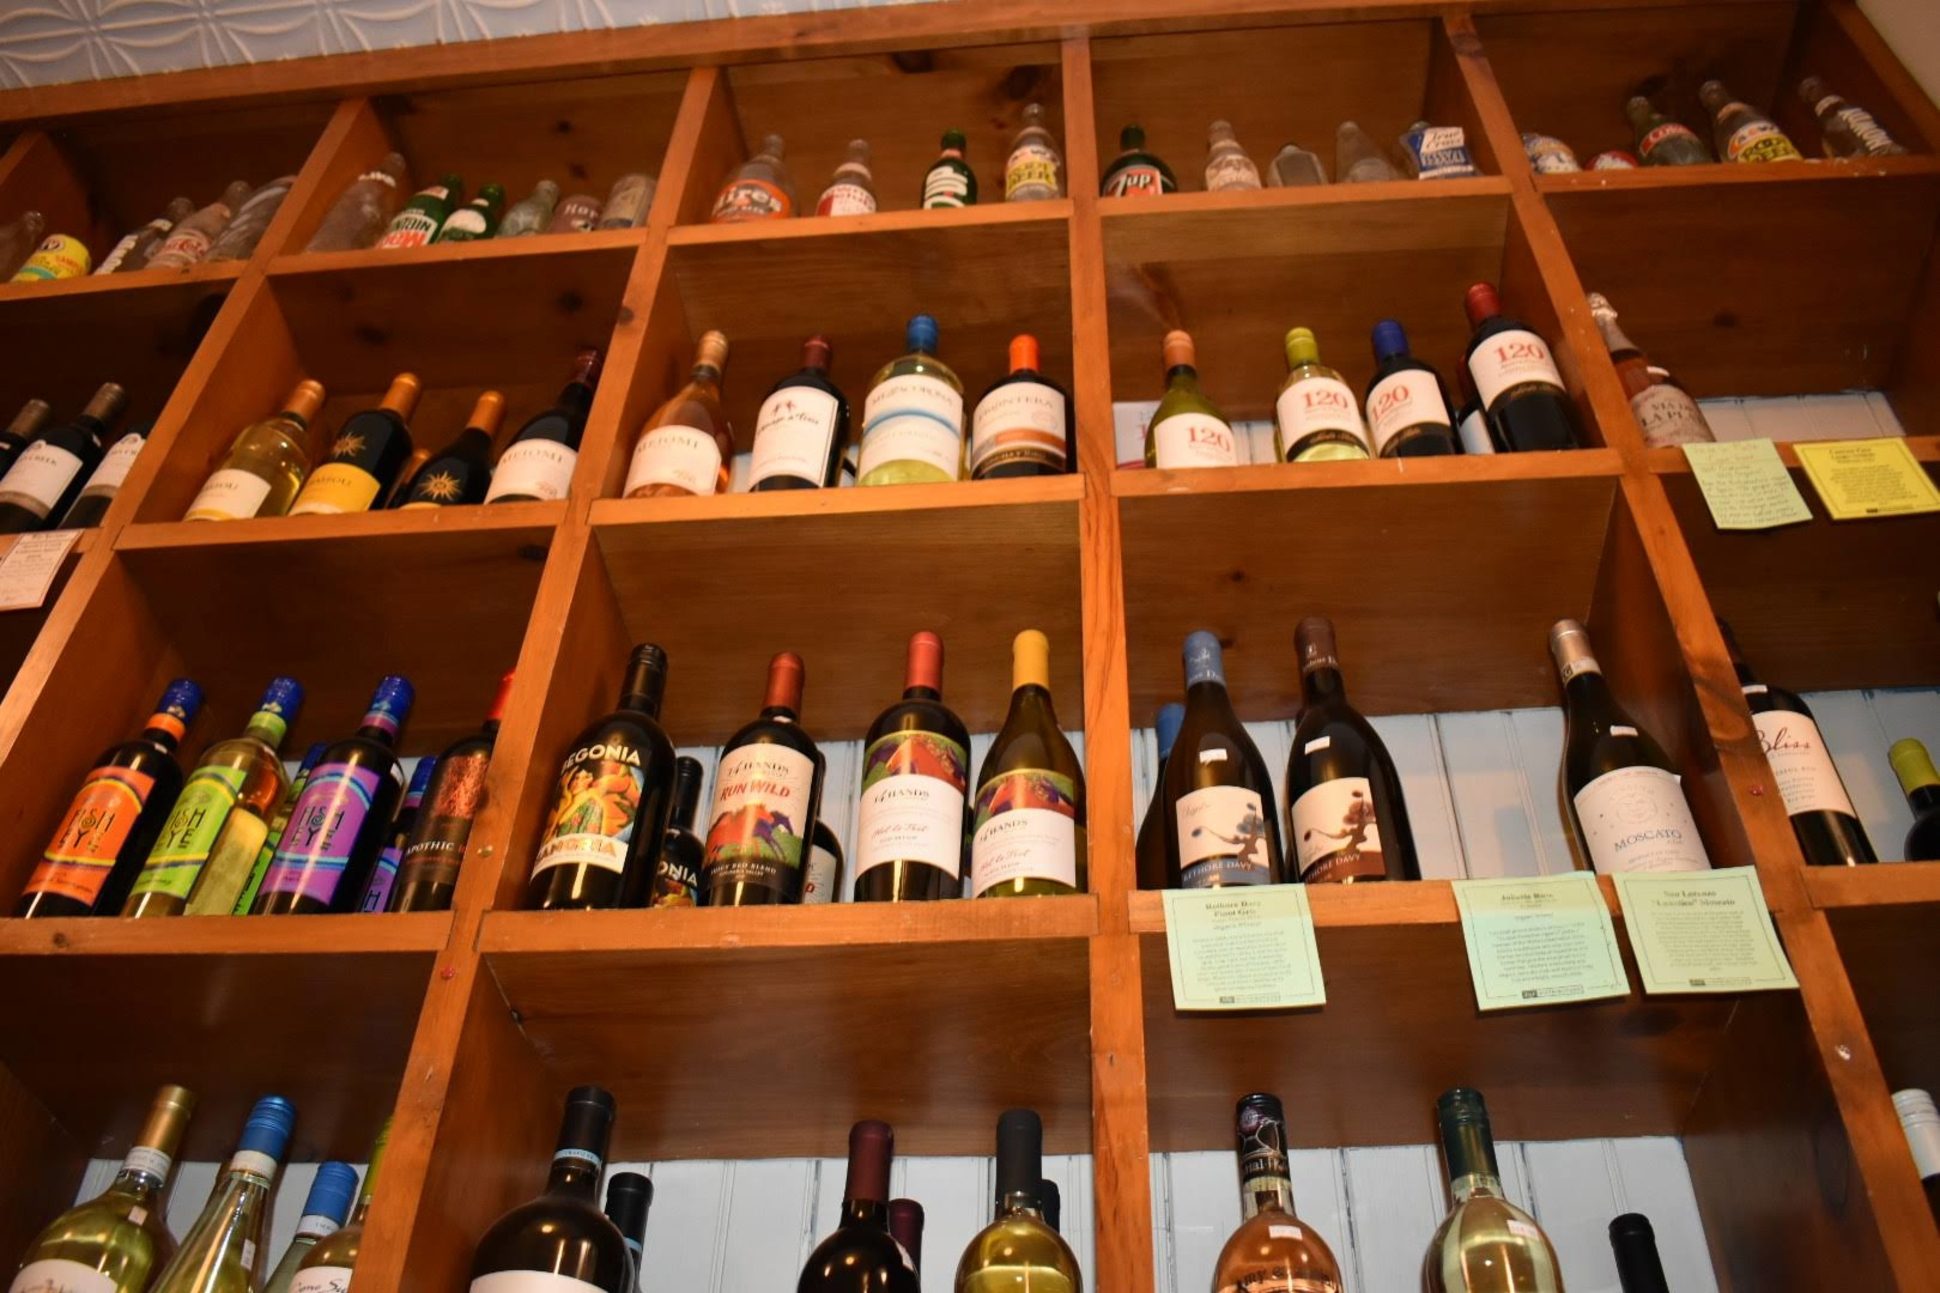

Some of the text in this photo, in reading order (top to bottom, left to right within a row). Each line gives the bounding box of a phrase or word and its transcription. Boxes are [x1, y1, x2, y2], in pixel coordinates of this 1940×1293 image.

[1495, 342, 1544, 362] 120
[1304, 390, 1348, 408] 120
[1371, 385, 1409, 423] 120
[1188, 426, 1230, 453] 120
[721, 780, 791, 801] RUN WILD
[1614, 828, 1682, 852] MOSCATO
[1335, 854, 1361, 866] DAVY
[658, 861, 698, 887] ONIA
